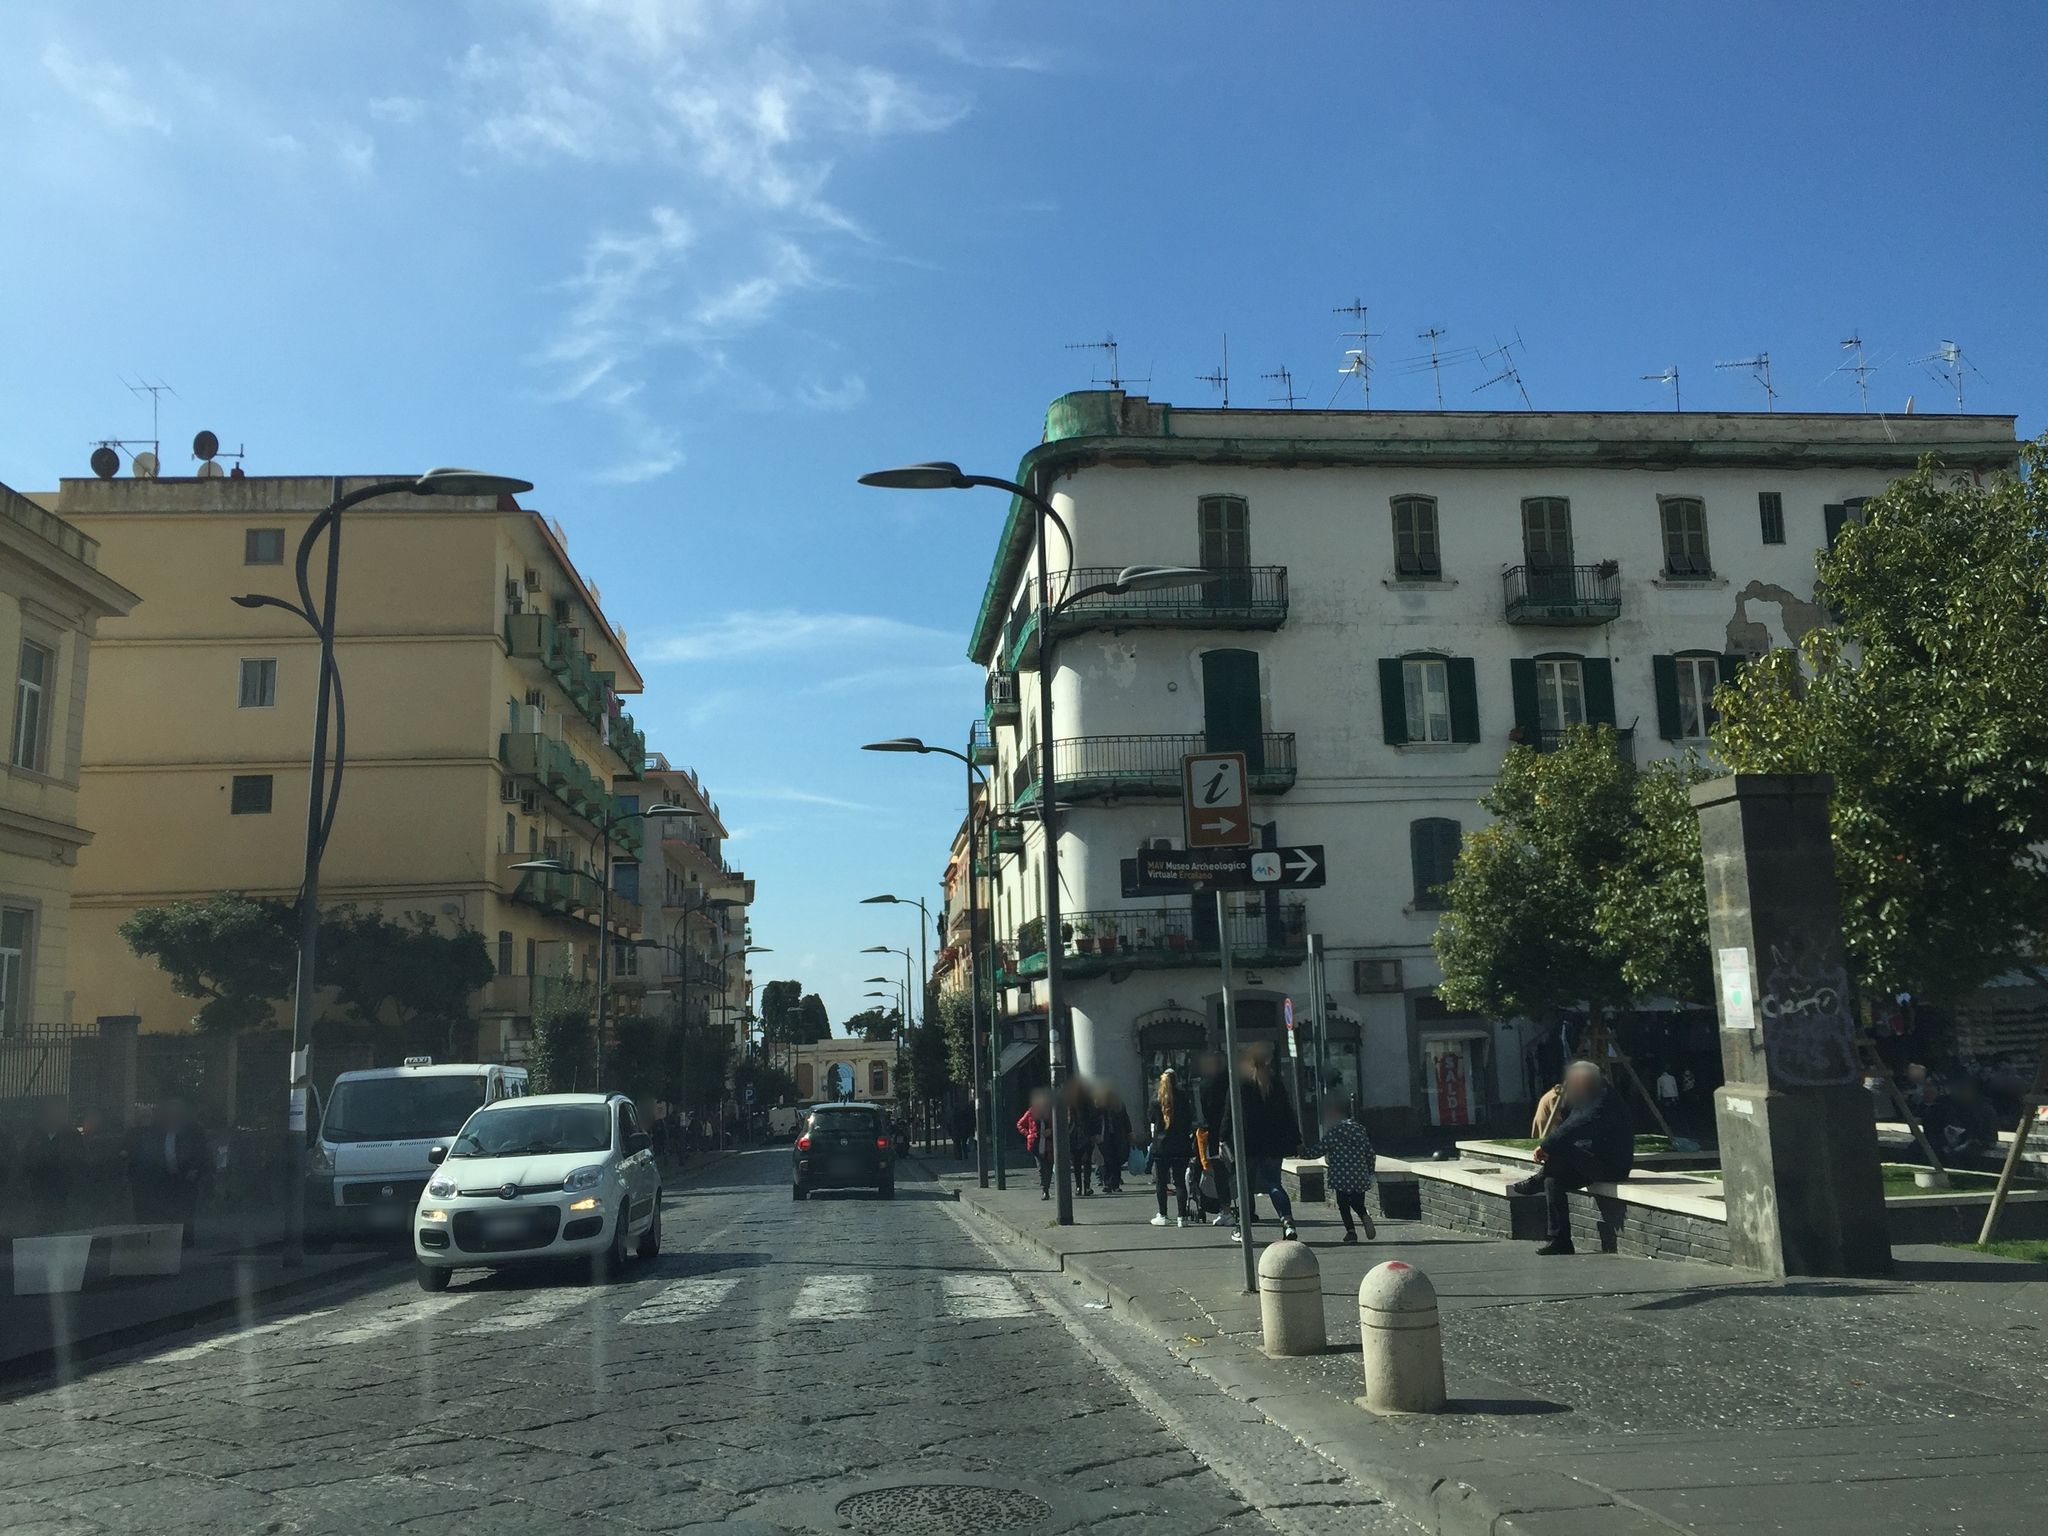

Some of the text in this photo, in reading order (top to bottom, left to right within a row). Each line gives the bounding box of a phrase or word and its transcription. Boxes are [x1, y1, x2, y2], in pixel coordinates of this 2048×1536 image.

[1147, 861, 1247, 872] MAV Museo Archeologico
[1148, 870, 1213, 880] Virtuale Ercolano
[745, 1089, 753, 1100] P
[1444, 1056, 1458, 1124] SALDI
